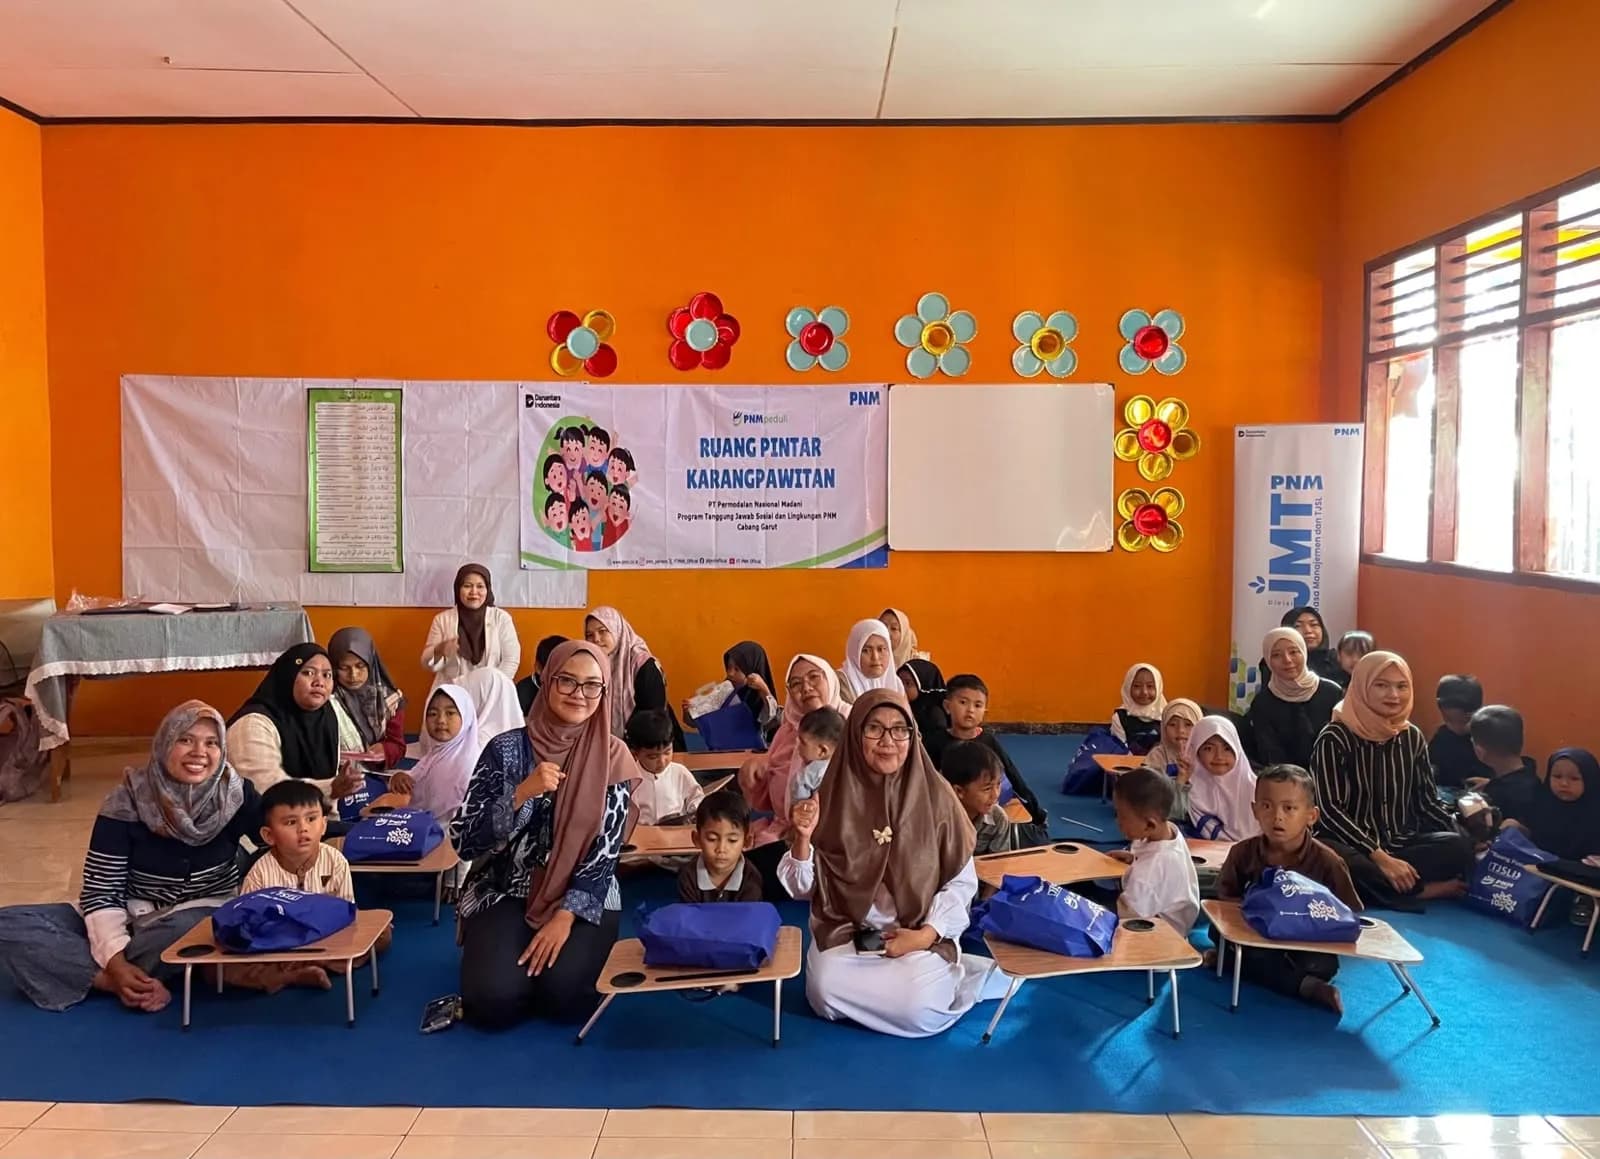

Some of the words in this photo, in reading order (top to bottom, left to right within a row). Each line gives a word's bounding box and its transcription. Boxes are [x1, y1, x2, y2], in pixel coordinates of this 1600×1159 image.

[849, 391, 880, 406] PNM
[1334, 428, 1360, 436] PNM
[700, 437, 757, 458] RUANG
[760, 437, 822, 458] PINTAR
[686, 468, 836, 490] KARANGPAWITAN
[1270, 475, 1324, 490] PNM
[754, 500, 780, 508] Nasional
[781, 500, 803, 508] Madani
[1314, 496, 1323, 516] TJSL
[677, 513, 703, 521] Program
[704, 512, 734, 521] Tanggung
[735, 512, 755, 520] Jawab
[755, 512, 774, 520] Sosial
[774, 512, 787, 520] dan
[787, 511, 822, 521] Lingkungan
[822, 511, 837, 519] PNM
[736, 523, 760, 531] Cabang
[760, 523, 778, 531] Garut
[1314, 517, 1323, 535] dan
[1313, 536, 1323, 590] Manajemen
